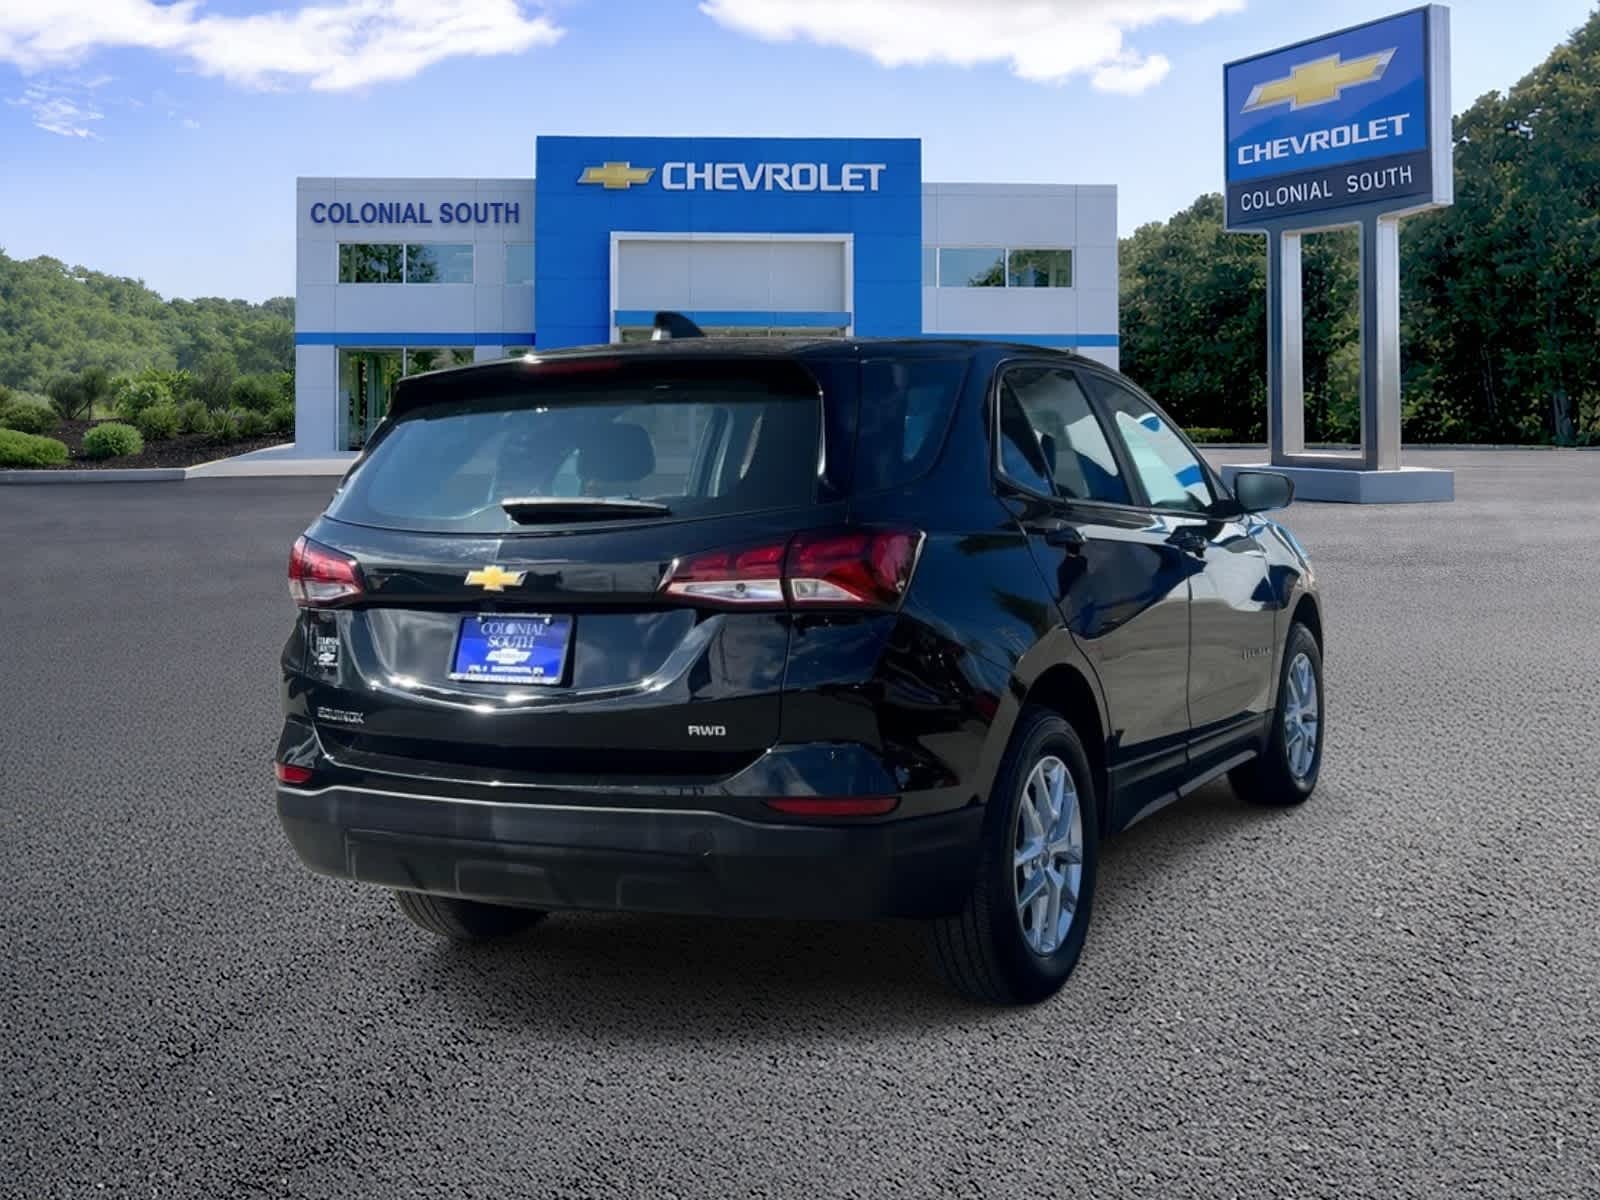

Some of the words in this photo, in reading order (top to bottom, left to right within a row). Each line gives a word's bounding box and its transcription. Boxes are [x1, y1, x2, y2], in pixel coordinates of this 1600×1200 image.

[1237, 113, 1410, 165] CHEVROLET
[661, 161, 887, 193] CHEVROLET
[1240, 180, 1333, 212] COLONIAL
[1346, 165, 1413, 194] SOUTH
[310, 202, 433, 225] COLONIAL
[438, 202, 520, 225] SOUTH
[487, 635, 535, 649] SOUTH
